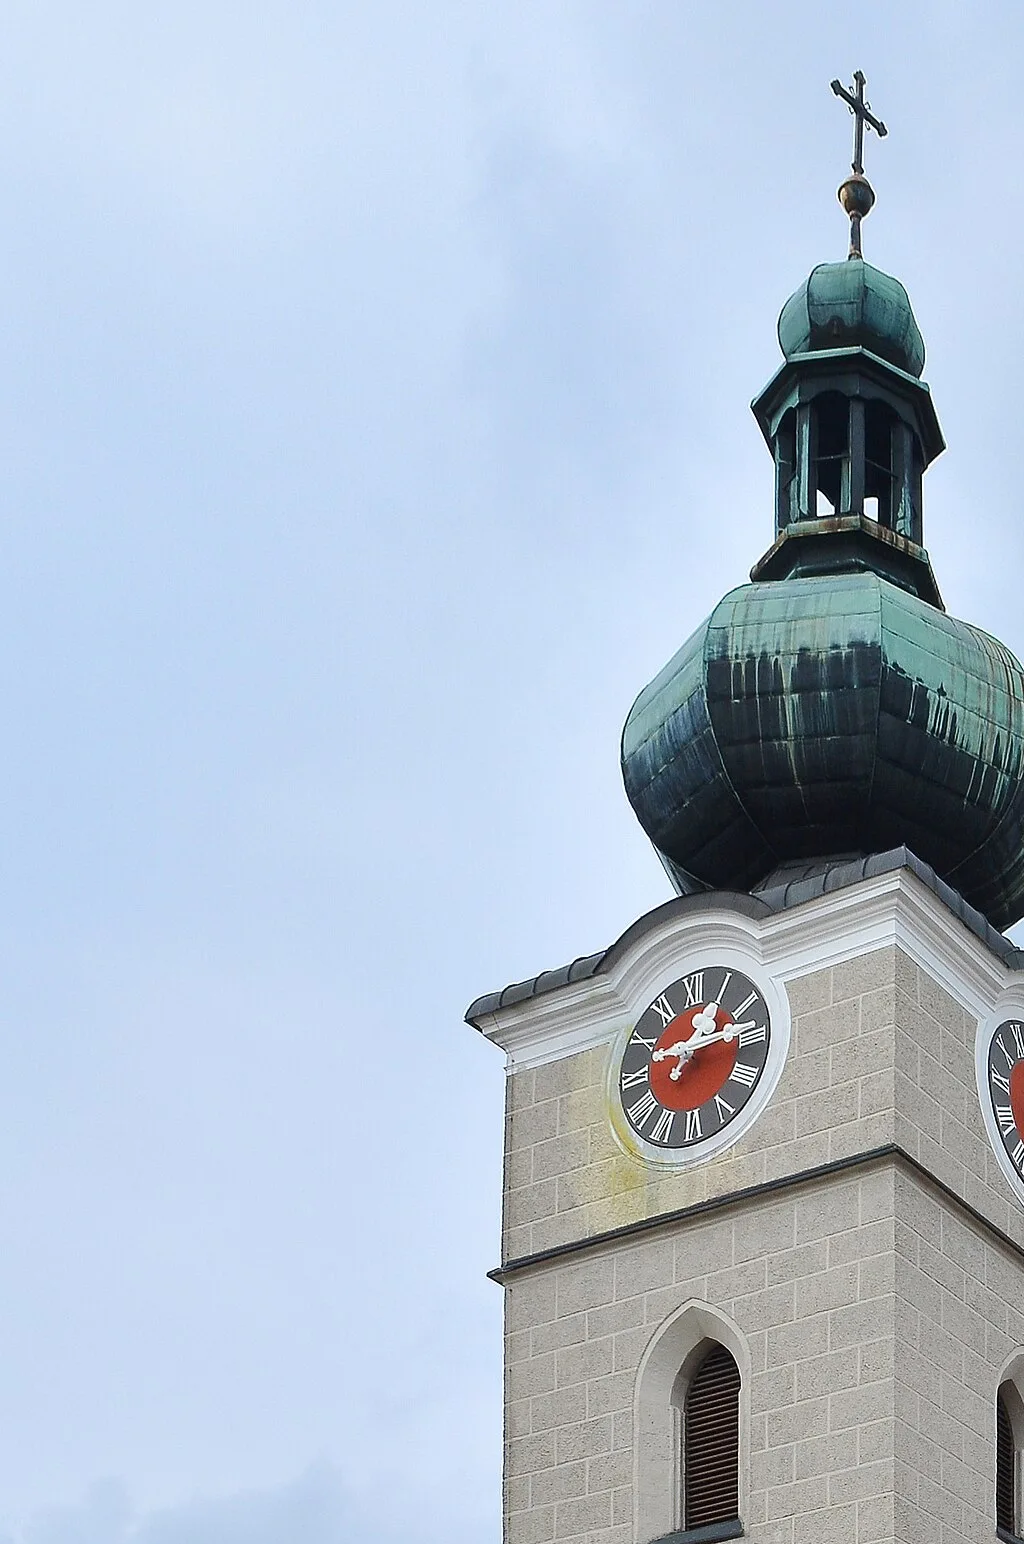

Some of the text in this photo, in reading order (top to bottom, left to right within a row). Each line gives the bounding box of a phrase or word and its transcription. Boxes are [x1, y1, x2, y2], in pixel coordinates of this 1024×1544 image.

[682, 972, 704, 1008] XII
[716, 972, 733, 1004] I
[650, 992, 677, 1027] XI
[732, 990, 759, 1020] II
[630, 1030, 657, 1051] X
[738, 1025, 766, 1048] III
[996, 1033, 1015, 1070] X
[622, 1064, 649, 1091] IX
[729, 1062, 759, 1088] IIII
[991, 1063, 1010, 1095] IX
[627, 1089, 659, 1130] VIII
[714, 1094, 735, 1124] V
[996, 1104, 1016, 1138] VIII
[649, 1109, 676, 1142] VII
[683, 1109, 703, 1142] VI
